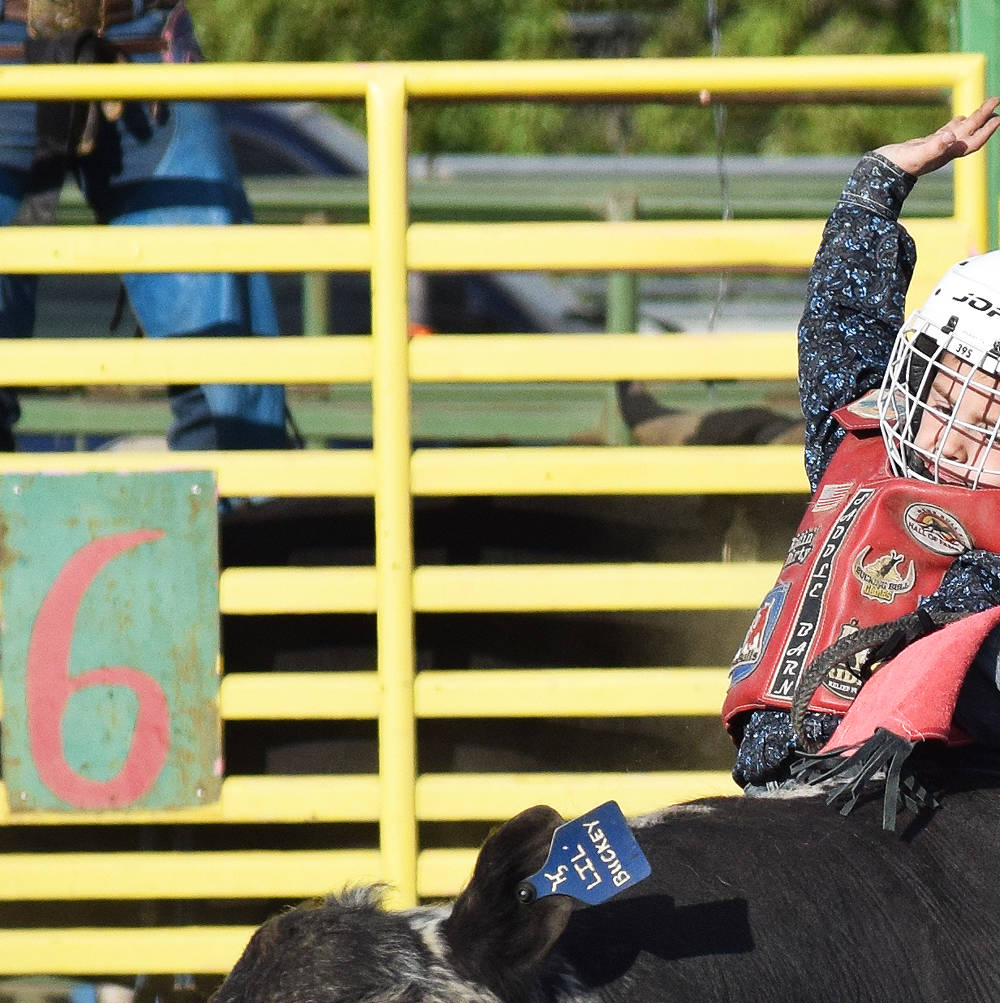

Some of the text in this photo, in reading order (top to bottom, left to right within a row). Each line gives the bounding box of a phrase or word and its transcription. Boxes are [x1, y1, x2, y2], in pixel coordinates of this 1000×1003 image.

[955, 343, 974, 359] 395
[908, 521, 927, 537] HALL
[25, 528, 171, 809] 6
[774, 621, 814, 695] BARN
[582, 820, 631, 887] BUCKEY
